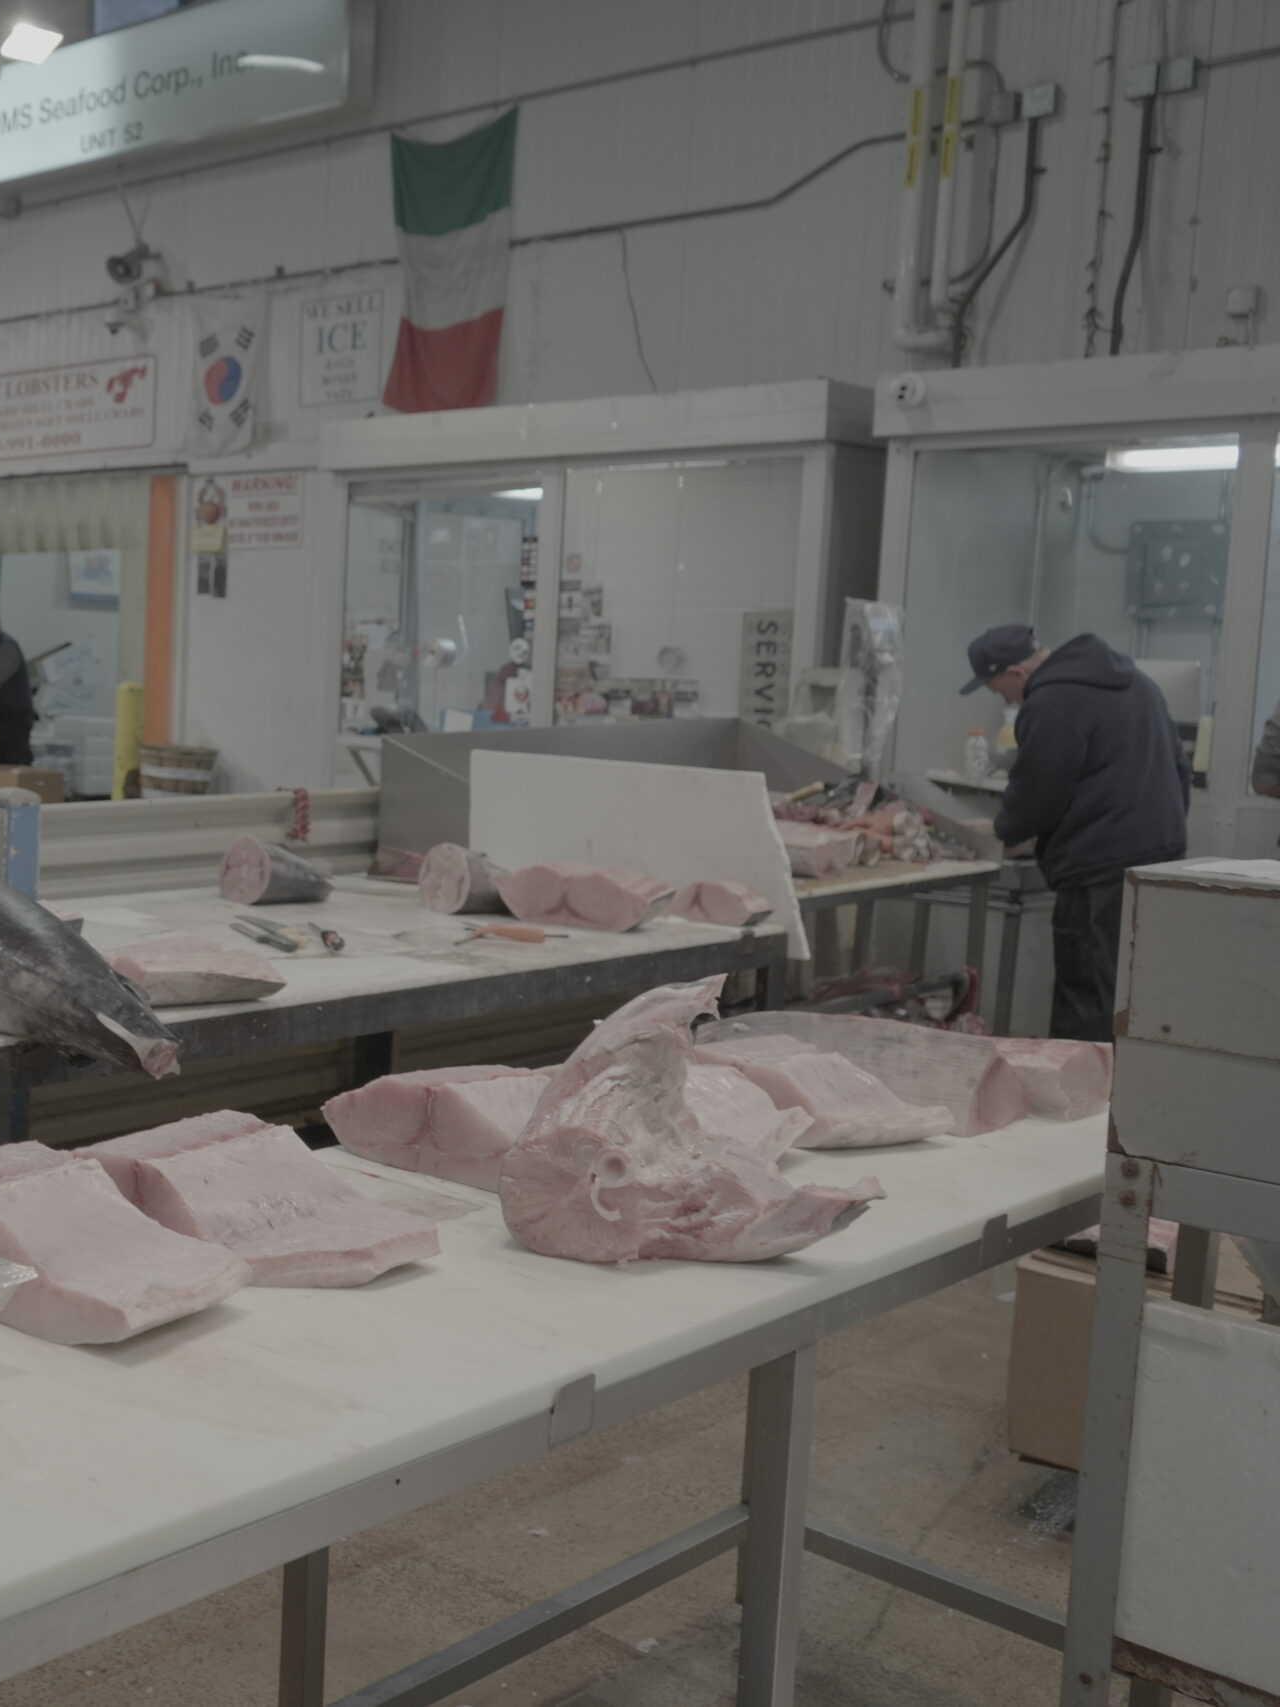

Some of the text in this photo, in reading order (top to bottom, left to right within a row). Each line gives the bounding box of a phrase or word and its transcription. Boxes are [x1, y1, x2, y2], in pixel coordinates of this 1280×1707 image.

[38, 78, 127, 125] Seafood
[133, 66, 204, 98] Corp.,
[80, 121, 145, 154] UNIT 52
[336, 296, 379, 315] SELL
[317, 320, 368, 355] ICE
[6, 371, 99, 398] LOBSTERS
[232, 474, 298, 492] WARNING!
